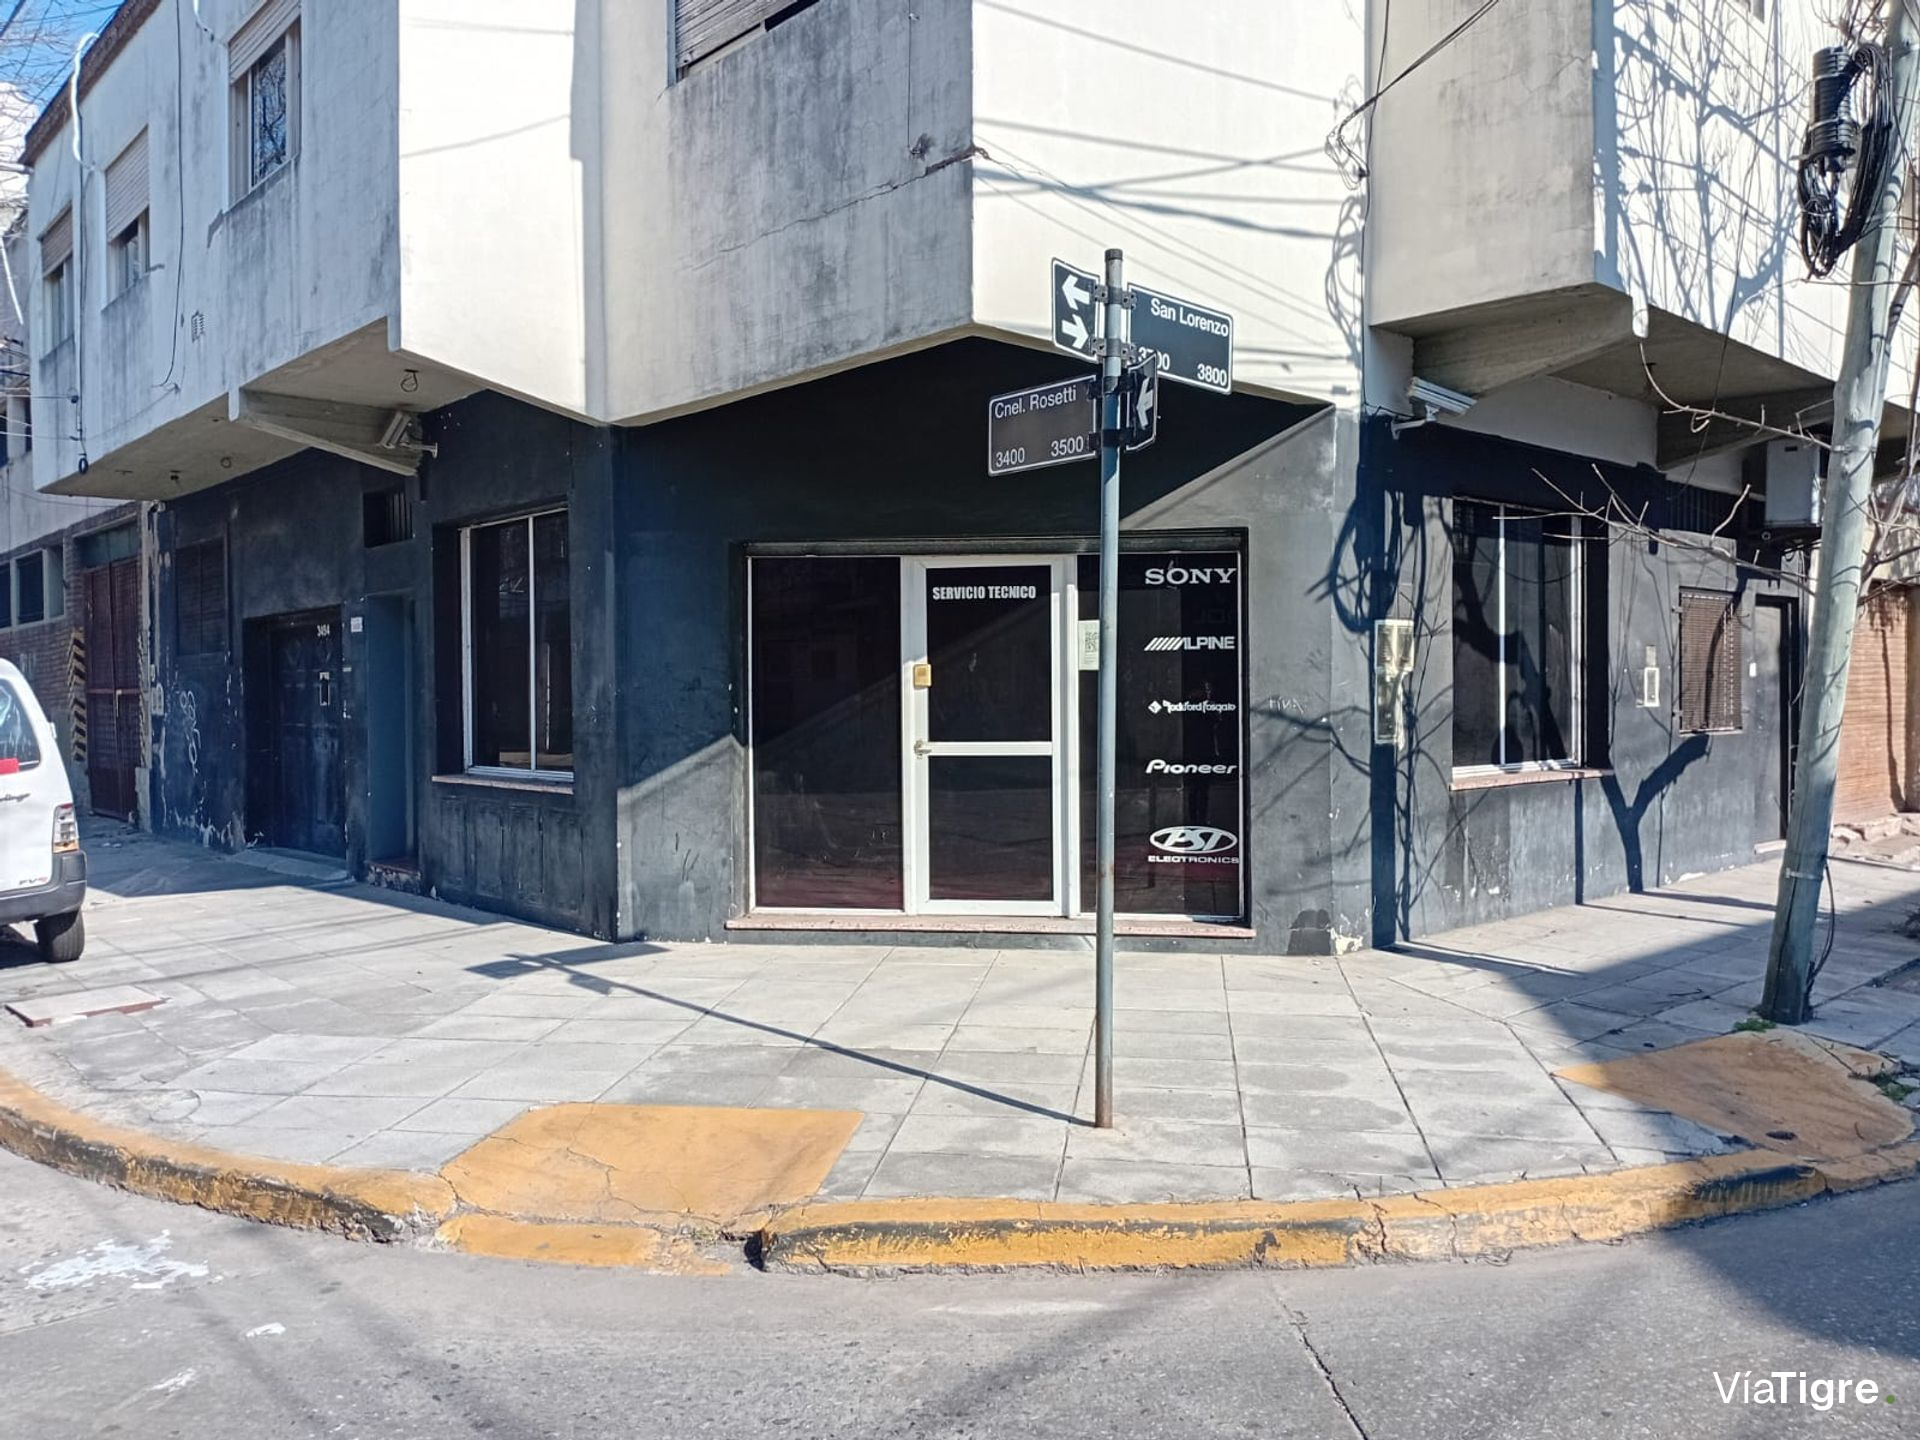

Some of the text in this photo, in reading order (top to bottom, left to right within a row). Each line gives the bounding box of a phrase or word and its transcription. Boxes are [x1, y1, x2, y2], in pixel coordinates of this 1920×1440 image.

[1150, 298, 1229, 337] San Lorenzo
[1138, 346, 1228, 386] 300 3800
[994, 385, 1077, 418] Cnel. Rosetti
[995, 436, 1084, 467] 3400 3500
[1145, 568, 1237, 585] SONY
[932, 585, 1036, 600] SERVICIO TECNICO
[1145, 759, 1238, 774] Pioneer
[1147, 855, 1240, 864] ELECTRONICS
